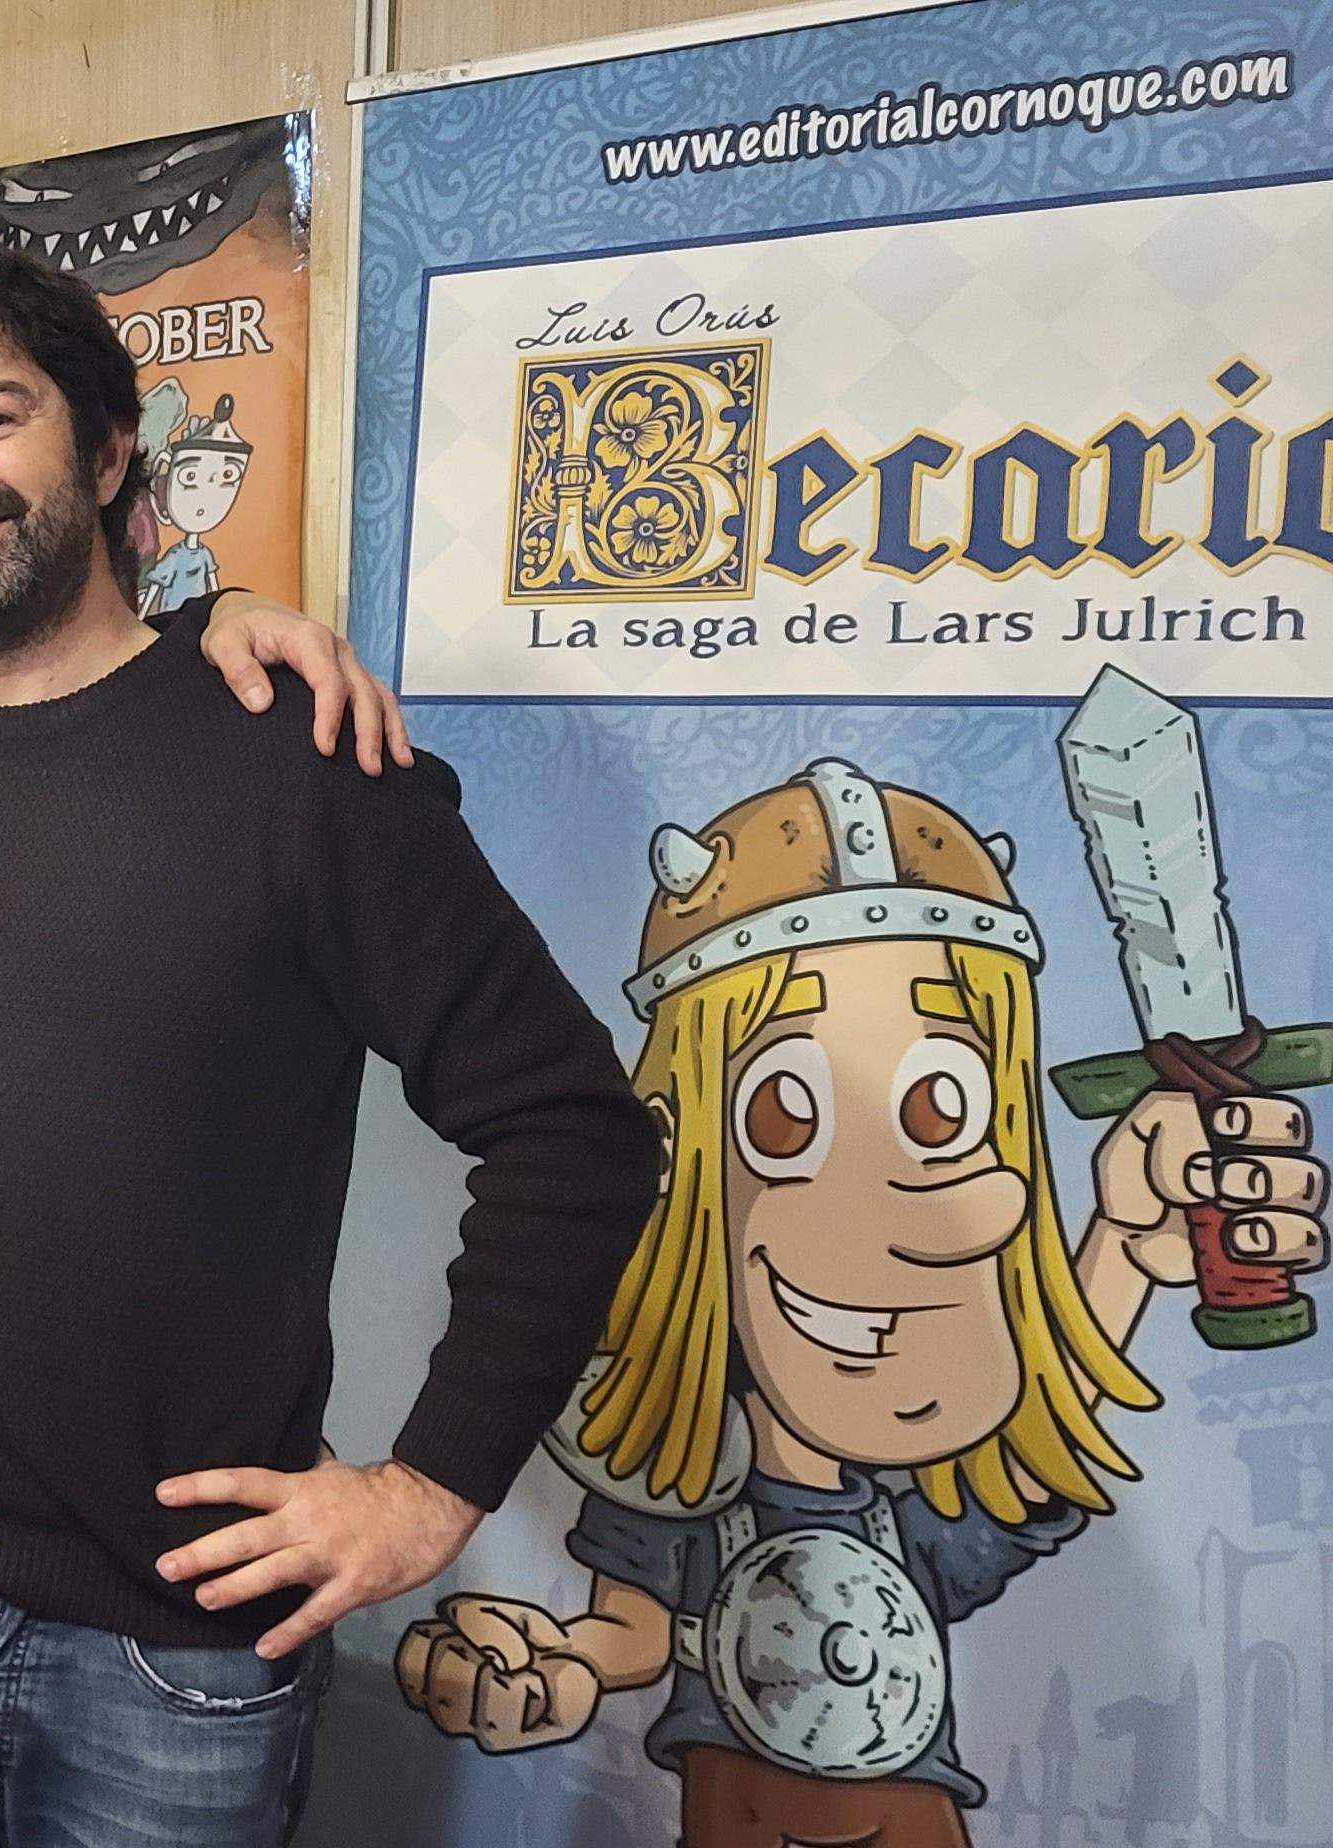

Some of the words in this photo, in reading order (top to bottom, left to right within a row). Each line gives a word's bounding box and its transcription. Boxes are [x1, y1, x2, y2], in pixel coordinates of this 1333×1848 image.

[601, 48, 1291, 184] www.editorialcornoque.com
[106, 296, 273, 367] OBER
[514, 302, 634, 350] Luis
[656, 292, 781, 335] Orús
[527, 608, 599, 651] La
[623, 614, 758, 660] saga
[784, 601, 858, 646] de
[886, 600, 1034, 646] Lars
[1062, 595, 1307, 645] Julrich
